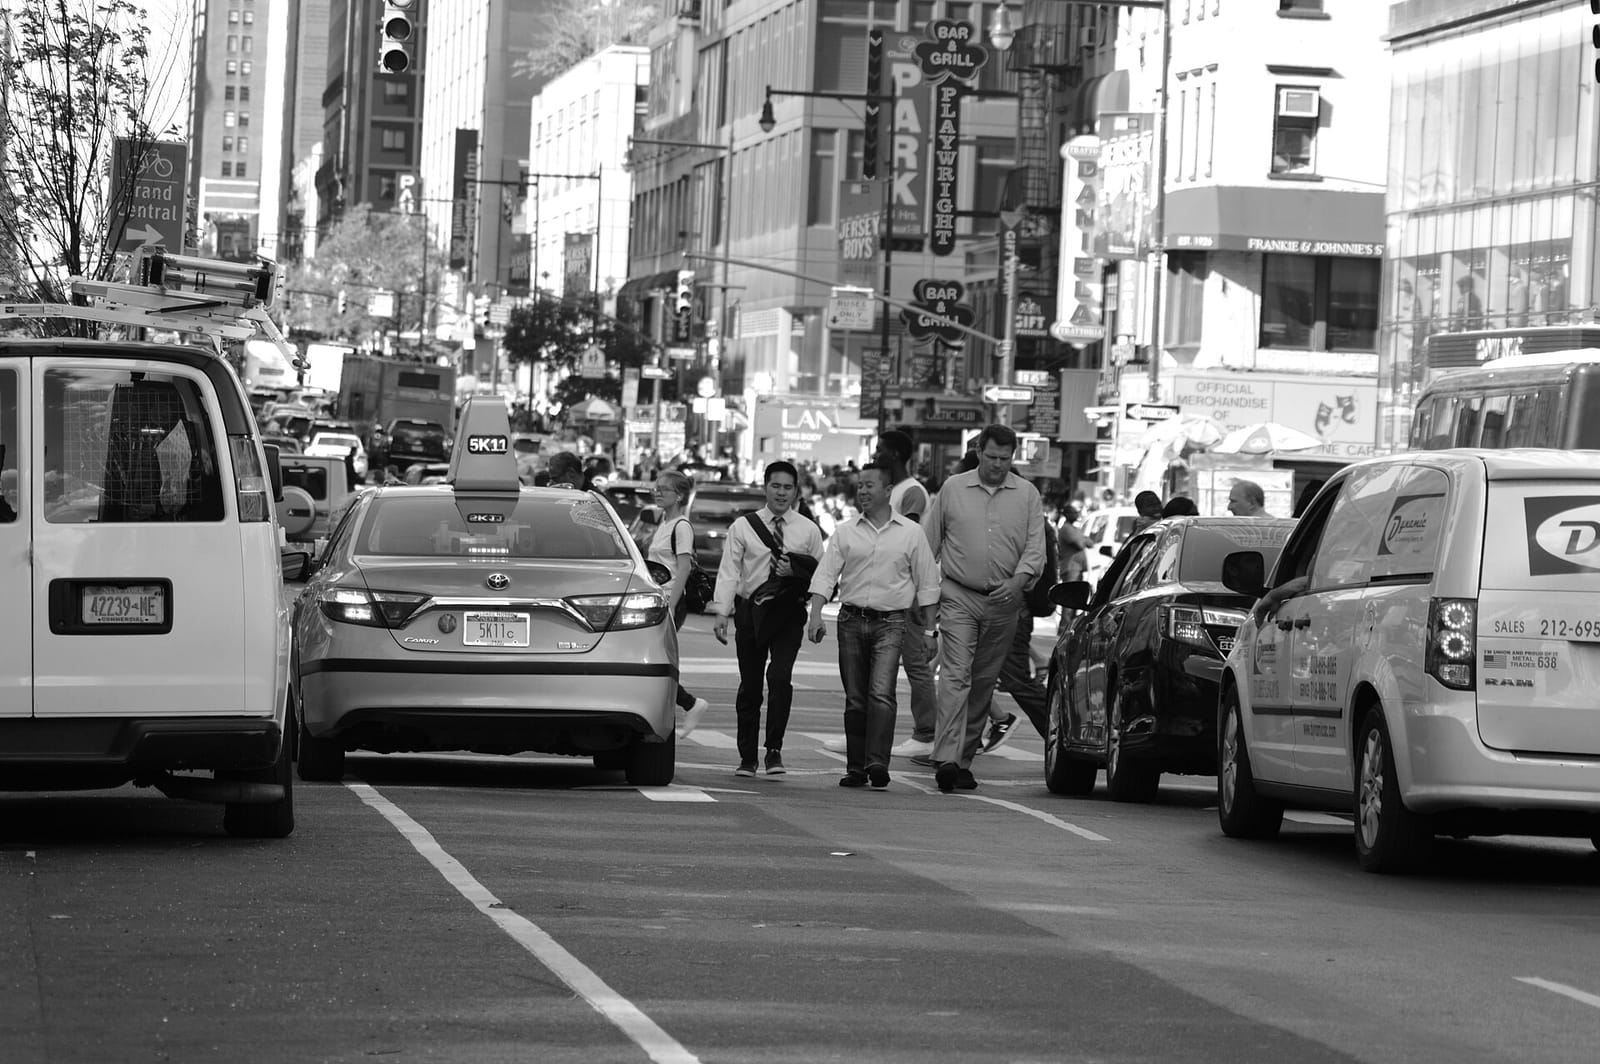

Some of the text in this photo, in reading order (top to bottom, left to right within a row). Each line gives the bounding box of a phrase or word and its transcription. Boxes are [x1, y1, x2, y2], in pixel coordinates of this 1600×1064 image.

[938, 26, 969, 40] BAR
[947, 40, 958, 52] &
[929, 52, 975, 67] GRILL
[891, 62, 922, 206] PARK
[934, 87, 958, 245] PLAYWRIGHT
[838, 215, 881, 240] JERSEY
[842, 238, 873, 260] BOYS
[1247, 238, 1299, 252] FRANKIE
[1301, 240, 1312, 252] &
[1313, 240, 1374, 255] JOHNNIE'S
[926, 287, 957, 301] BAR
[936, 301, 946, 314] &
[1196, 381, 1255, 396] OFFICIAL
[1177, 395, 1269, 410] MERCHANDISE
[1212, 410, 1230, 421] OF
[469, 438, 508, 453] 5K11
[1494, 619, 1600, 638] SALES 212-695
[1537, 656, 1557, 669] 638
